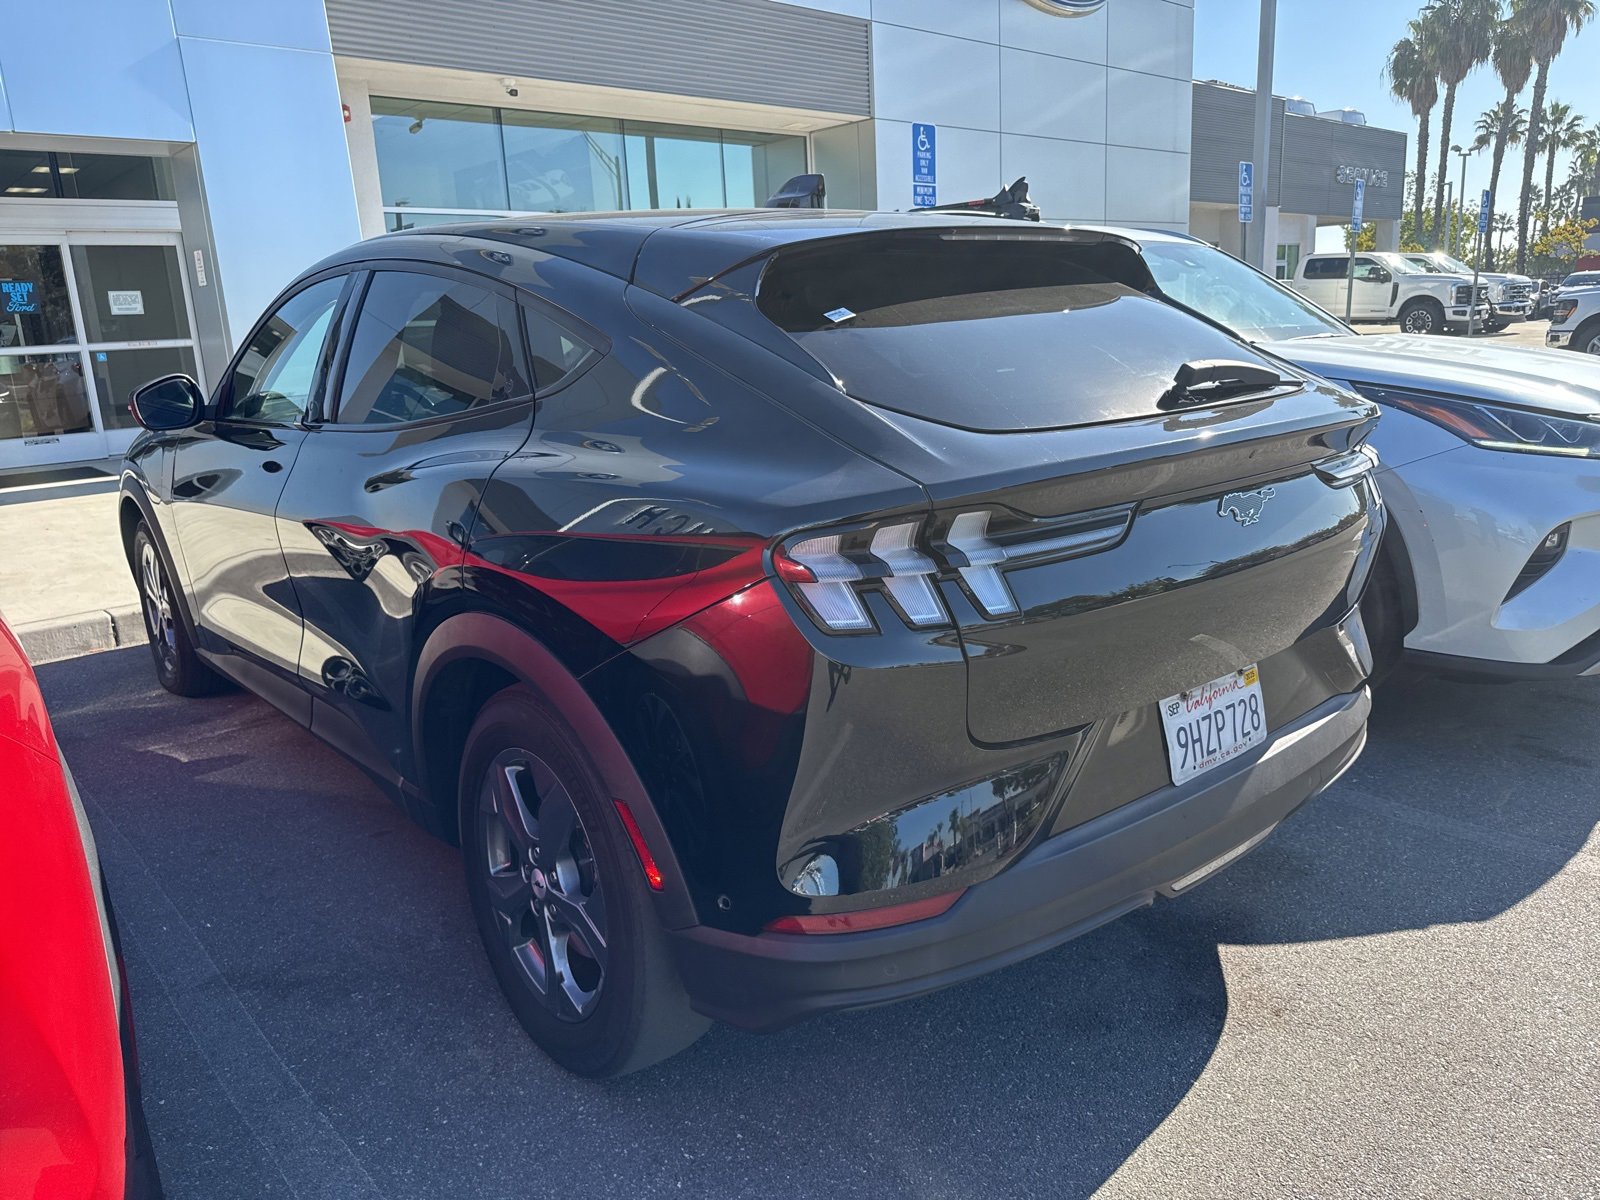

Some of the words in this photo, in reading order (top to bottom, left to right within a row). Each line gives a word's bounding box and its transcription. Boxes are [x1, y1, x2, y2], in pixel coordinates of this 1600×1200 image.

[2, 282, 33, 293] READY
[10, 292, 28, 302] SET
[7, 301, 35, 312] Ford
[1186, 680, 1245, 713] California
[1168, 702, 1180, 717] SEP
[1176, 693, 1260, 769] 9HZP728
[1199, 741, 1247, 769] dmv.ca.gov
